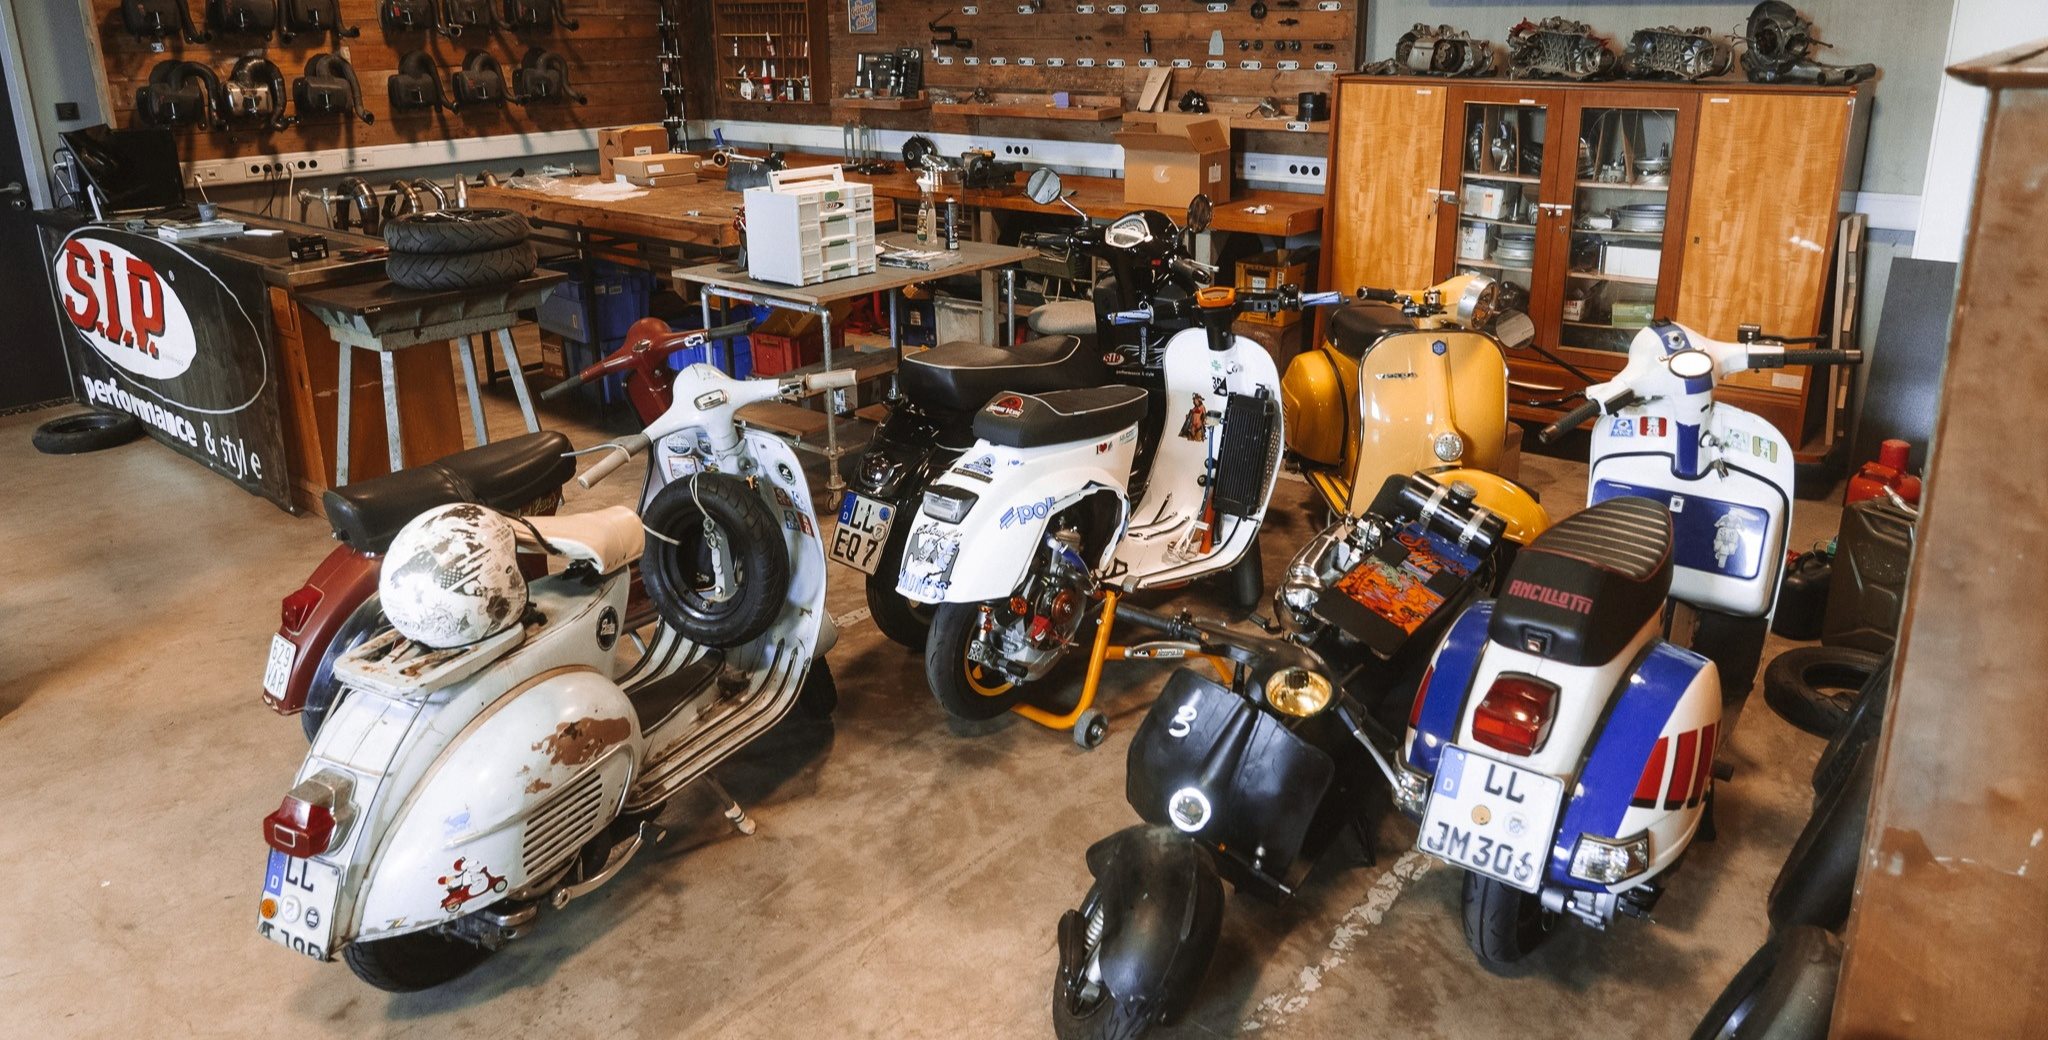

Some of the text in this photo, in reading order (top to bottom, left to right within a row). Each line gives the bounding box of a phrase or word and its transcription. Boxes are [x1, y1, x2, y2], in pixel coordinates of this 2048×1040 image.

[83, 374, 198, 447] performance
[203, 421, 218, 458] &
[849, 500, 875, 534] LL
[833, 527, 879, 567] EQ 7
[1508, 578, 1594, 615] ANCILLOTTI
[1168, 704, 1198, 738] 3
[1484, 763, 1525, 804] LL
